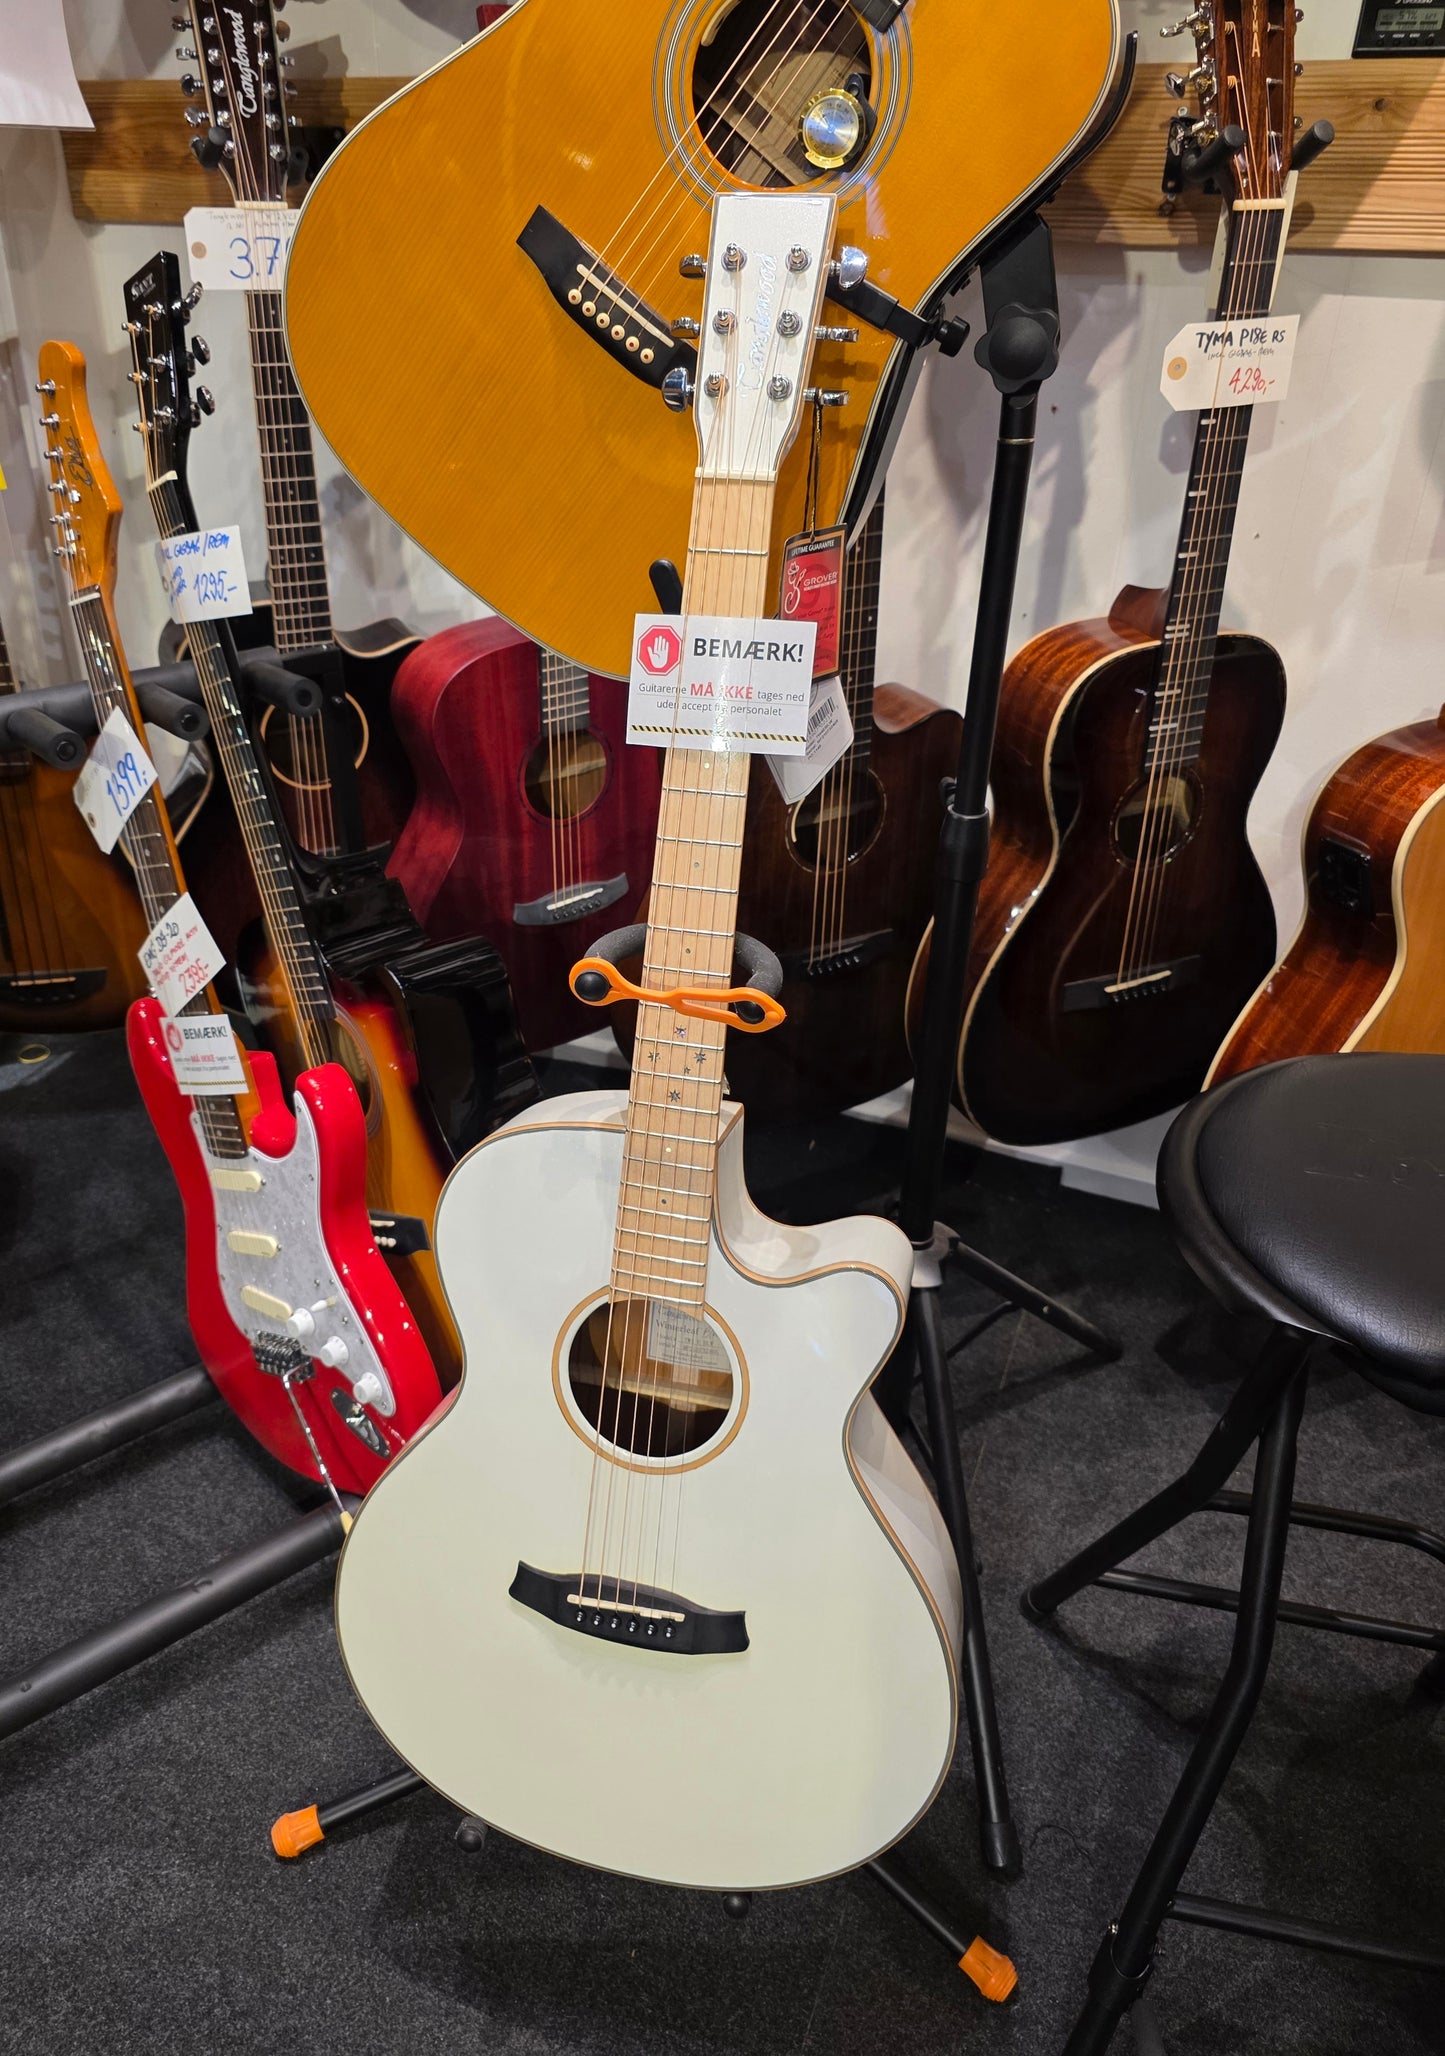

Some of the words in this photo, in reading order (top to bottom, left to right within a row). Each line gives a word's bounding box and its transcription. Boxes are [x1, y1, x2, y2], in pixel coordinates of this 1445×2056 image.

[223, 7, 259, 119] Tanglewood
[1196, 330, 1233, 353] TYMA
[1272, 329, 1286, 343] RS
[808, 539, 835, 553] GUARANTEE
[804, 572, 837, 588] GROVER
[693, 637, 804, 663] BEMÆRK!
[638, 682, 687, 696] Guitarerne
[690, 681, 714, 697] MÅ
[757, 690, 783, 702] tages
[786, 692, 805, 702] ned
[656, 699, 679, 709] uden
[681, 701, 712, 713] accept
[730, 704, 782, 717] personalet
[183, 1025, 229, 1040] BEMÆRK!
